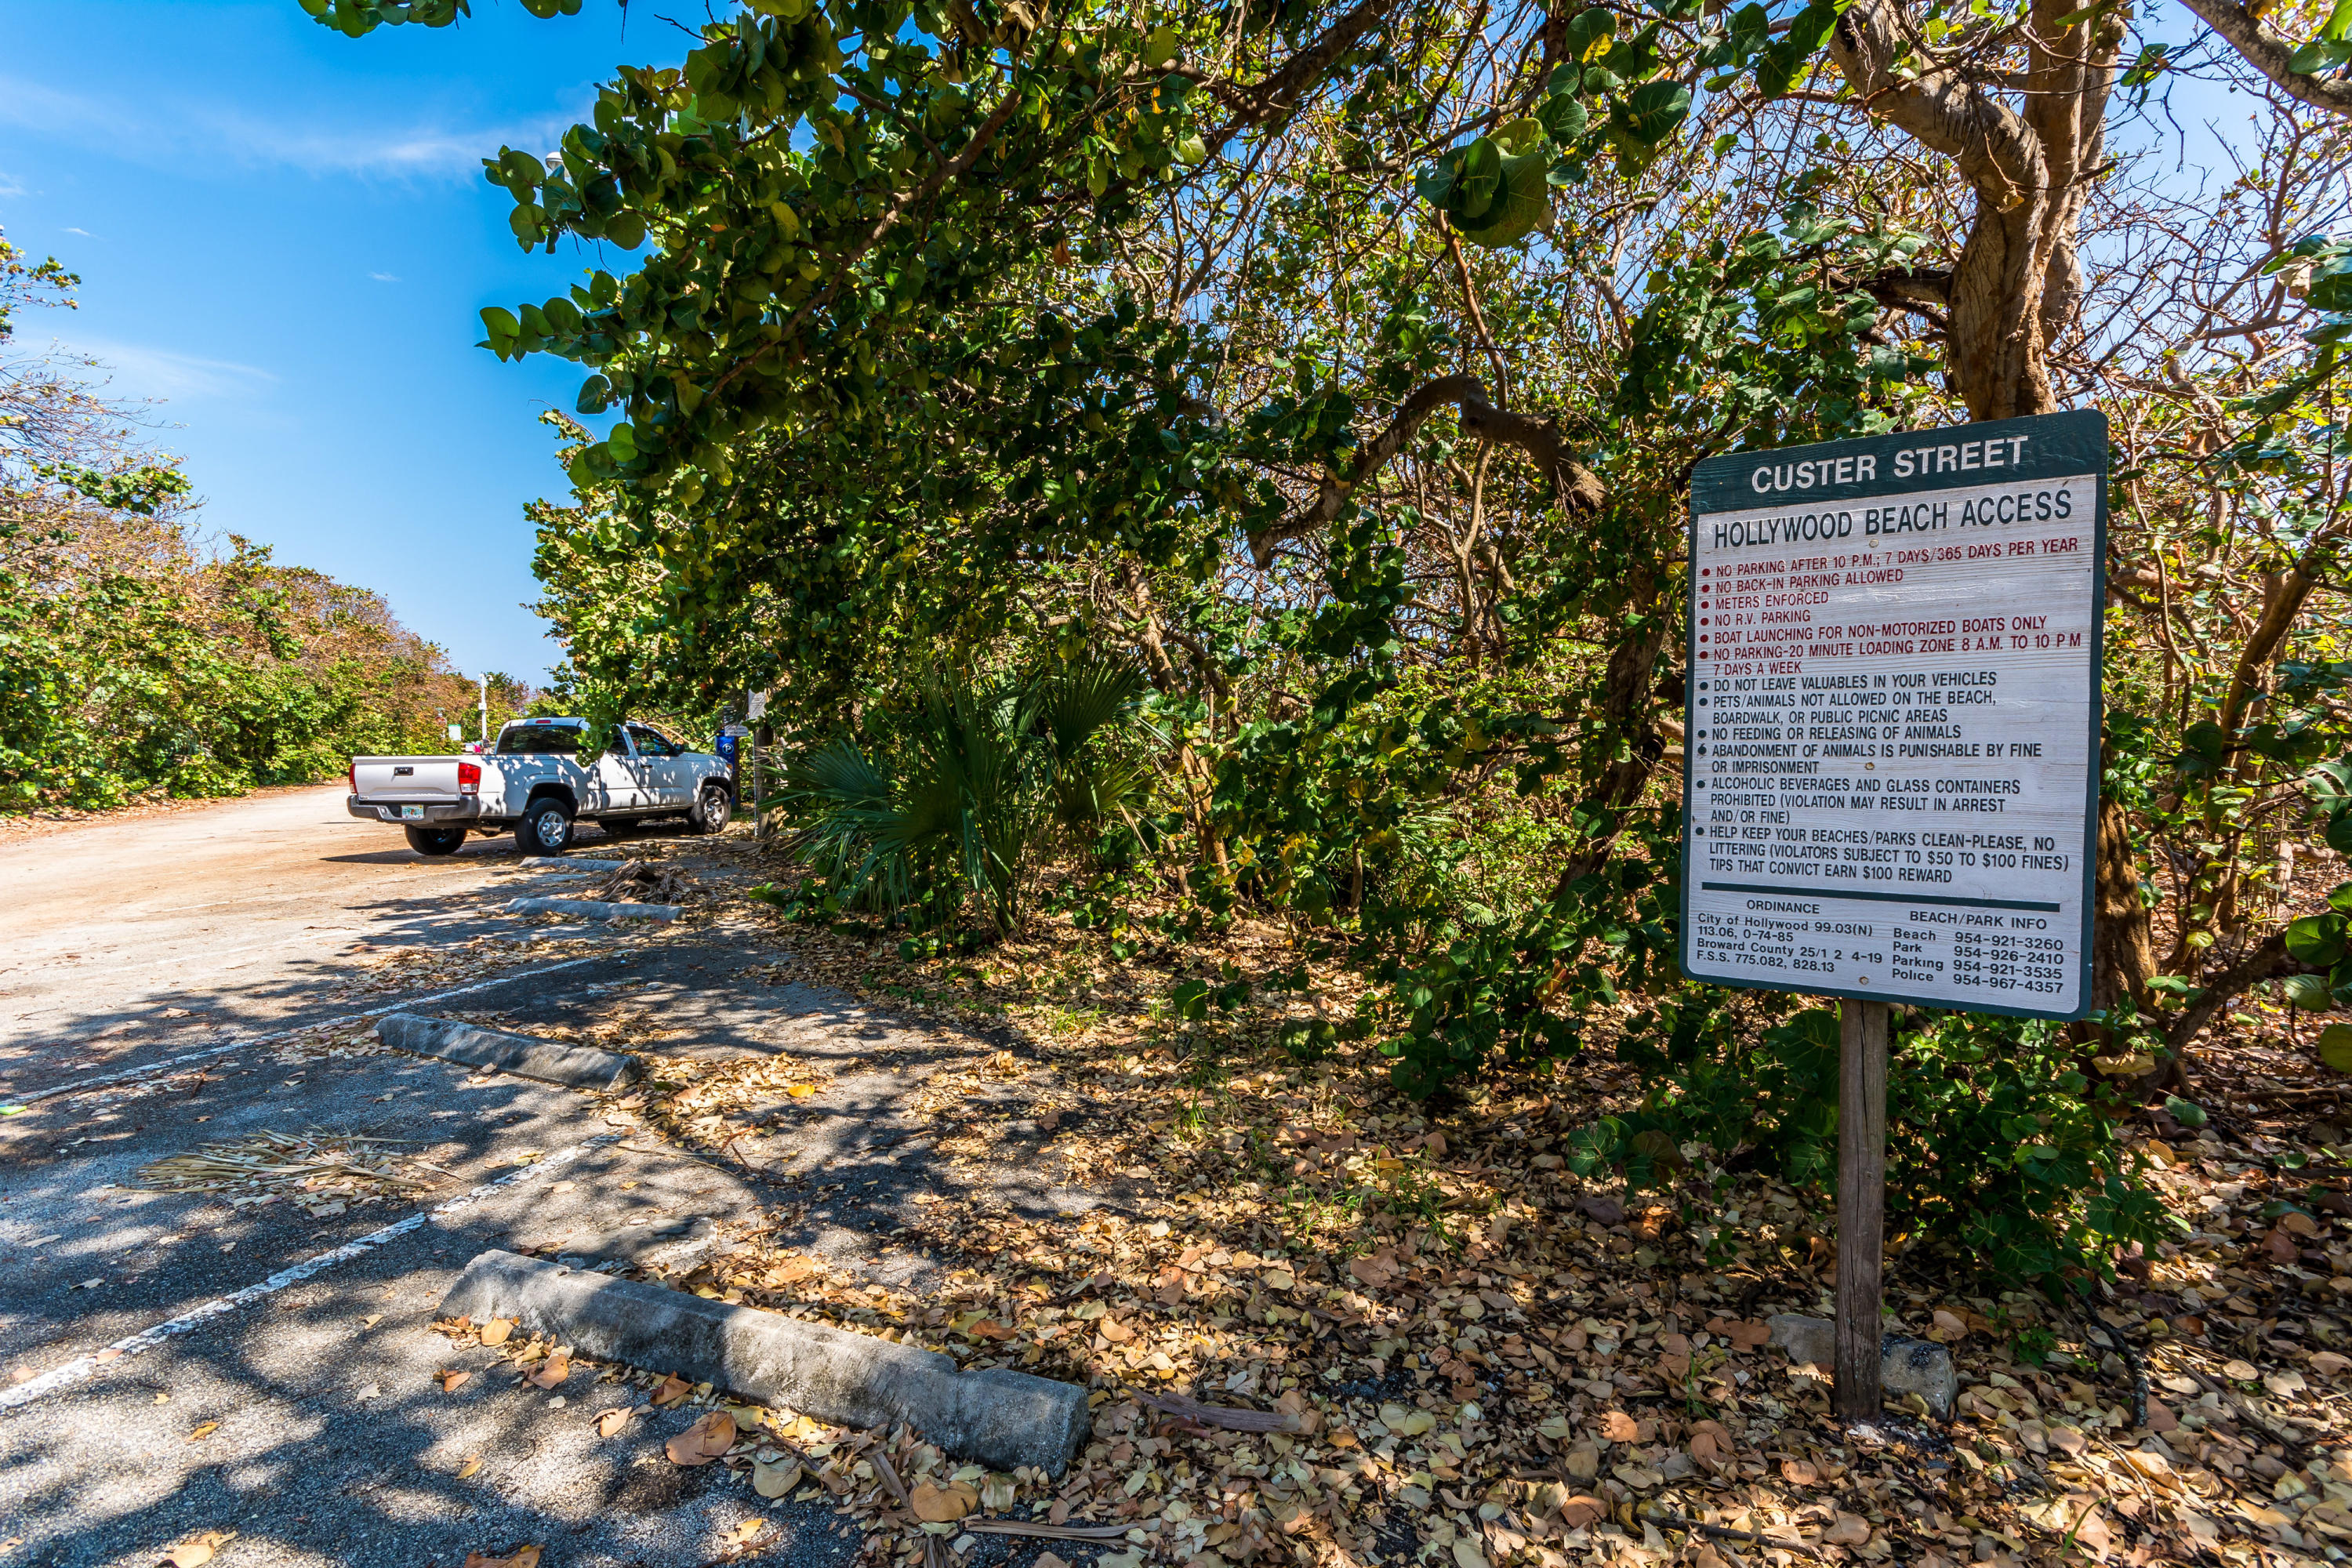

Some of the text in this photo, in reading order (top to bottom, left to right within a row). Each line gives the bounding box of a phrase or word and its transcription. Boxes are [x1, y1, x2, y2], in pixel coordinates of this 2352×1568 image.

[1752, 436, 2028, 493] CUSTER STREET
[1715, 490, 2071, 549] HOLLYWOOD BEACH ACCESS
[1717, 538, 2078, 577] NO PARKING AFTER 10 P.M.; 7 DAYS/365 DAYS PER YEAR
[1716, 568, 1904, 593] NO BACK-IN PARKING ALLOWED
[1715, 591, 1828, 610] METERS ENFORCED
[1715, 610, 1810, 626] NO R.V. PARKING
[1715, 616, 2046, 644] BOAT LAUNCHING FOR NON-MOTORIZED BOATS ONLY
[1714, 648, 1730, 661] NO
[1735, 644, 1803, 659] PARKING-20
[1809, 643, 1849, 656] MINUTE
[1860, 640, 1913, 655] LOADING
[1920, 638, 1955, 652] ZONE
[1962, 637, 1969, 651] 8
[1976, 637, 2002, 650] A.M.
[2010, 635, 2027, 648] TO
[2035, 634, 2049, 648] 10
[1714, 662, 1802, 676] 7 DAYS A WEEK
[1715, 672, 1997, 691] DO NOT LEAVE VALUABLES IN YOUR VEHICLES
[1714, 690, 1995, 707] PETS/ANIMALS NOT ALLOWED ON THE BEACH,
[1713, 709, 1947, 725] BOARDWALK, OR PUBLIC PICNIC AREAS
[1712, 724, 1961, 741] NO FEEDING OR RELEASING OF ANIMALS
[1712, 743, 2042, 757] ABANDONMENT OF ANIMALS IS PUNISHABLE BY FINE
[1711, 760, 1819, 774] OR IMPRISONMENT
[1711, 777, 2020, 794] ALCOHOLIC BEVERAGES AND GLASS CONTAINERS
[1711, 793, 2005, 812] PROHIBITED (VIOLATION MAY RESULT IN ARREST
[1711, 810, 1790, 825] AND/OR FINE)
[1710, 826, 2055, 852] HELP KEEP YOUR BEACHES/PARKS CLEAN-PLEASE, NO
[1710, 842, 2068, 872] LITTERING (VIOLATORS SUBJECT TO $50 TO $100 FINES)
[1710, 858, 1951, 883] TIPS THAT CONVICT EARN $100 REWARD
[1747, 900, 1820, 914] ORDINANCE
[1698, 913, 1872, 937] City of Hollywood 99.03(N)
[1910, 911, 2047, 930] BEACH/PARK INFO
[1698, 926, 1737, 939] 113.06,
[1894, 927, 2063, 950] Beach 954-921-3260
[1697, 938, 1744, 950] Broward
[1751, 942, 1794, 957] County
[1852, 952, 1882, 964] 4-19
[1697, 950, 1835, 972] F.S.S. 775.082, 828.13
[1893, 942, 2063, 964] Park 954-926-2410
[1893, 955, 2063, 979] Parking 954-921-3535
[1893, 968, 2063, 993] Police 954-967-4357
